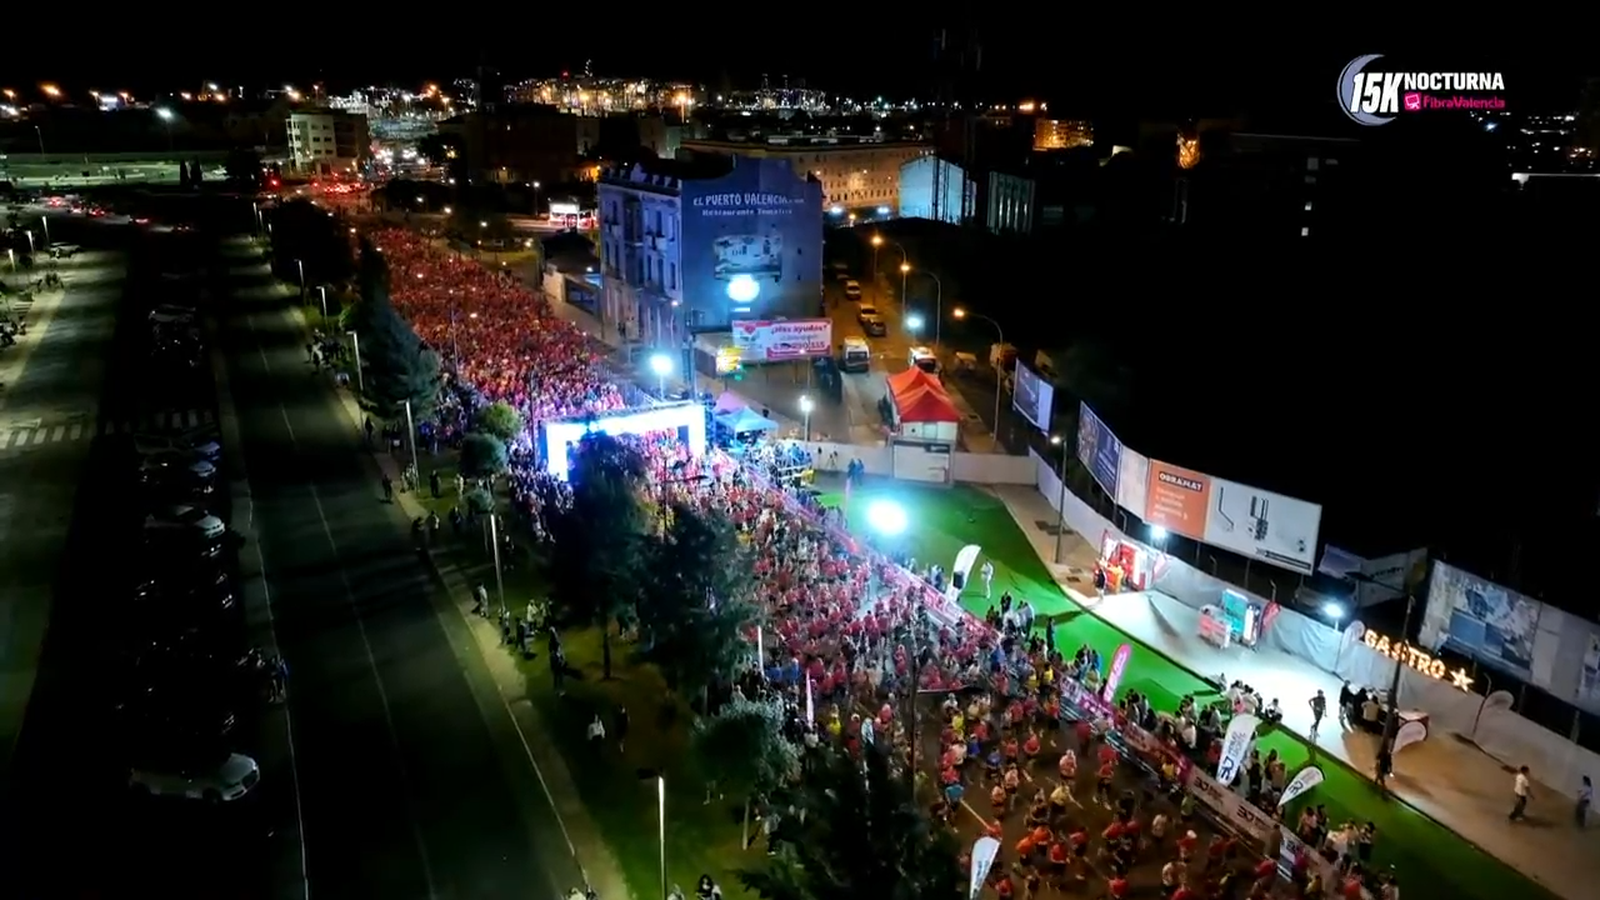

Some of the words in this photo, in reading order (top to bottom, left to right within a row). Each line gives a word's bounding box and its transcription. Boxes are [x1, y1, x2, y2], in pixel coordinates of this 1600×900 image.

[693, 197, 704, 206] EL
[705, 193, 742, 206] PUERTO
[1159, 473, 1202, 491] OBRAMAT
[1364, 629, 1446, 680] GASTRO
